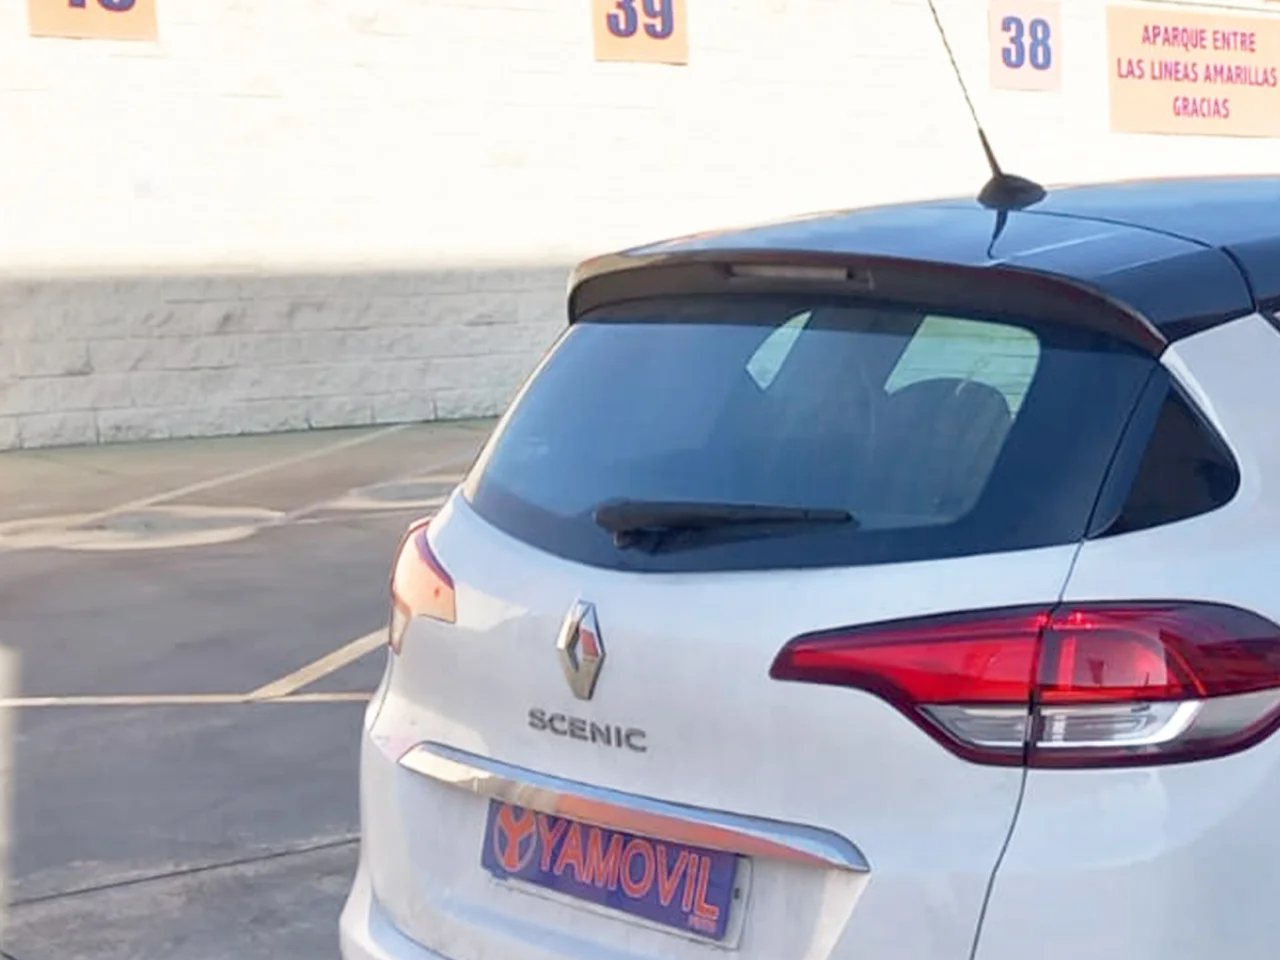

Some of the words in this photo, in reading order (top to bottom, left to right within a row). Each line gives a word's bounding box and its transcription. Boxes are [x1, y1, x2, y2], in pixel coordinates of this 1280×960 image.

[606, 0, 674, 40] 39
[1142, 25, 1207, 52] APARQUE
[1213, 30, 1257, 53] ENTRE
[1001, 16, 1052, 70] 38
[1117, 58, 1145, 80] LAS
[1151, 61, 1199, 83] LINEAS
[1203, 64, 1278, 88] AMARILLAS
[1173, 97, 1230, 119] GRACIAS
[528, 708, 648, 753] SCENIC
[538, 814, 720, 921] YAMOVIL
